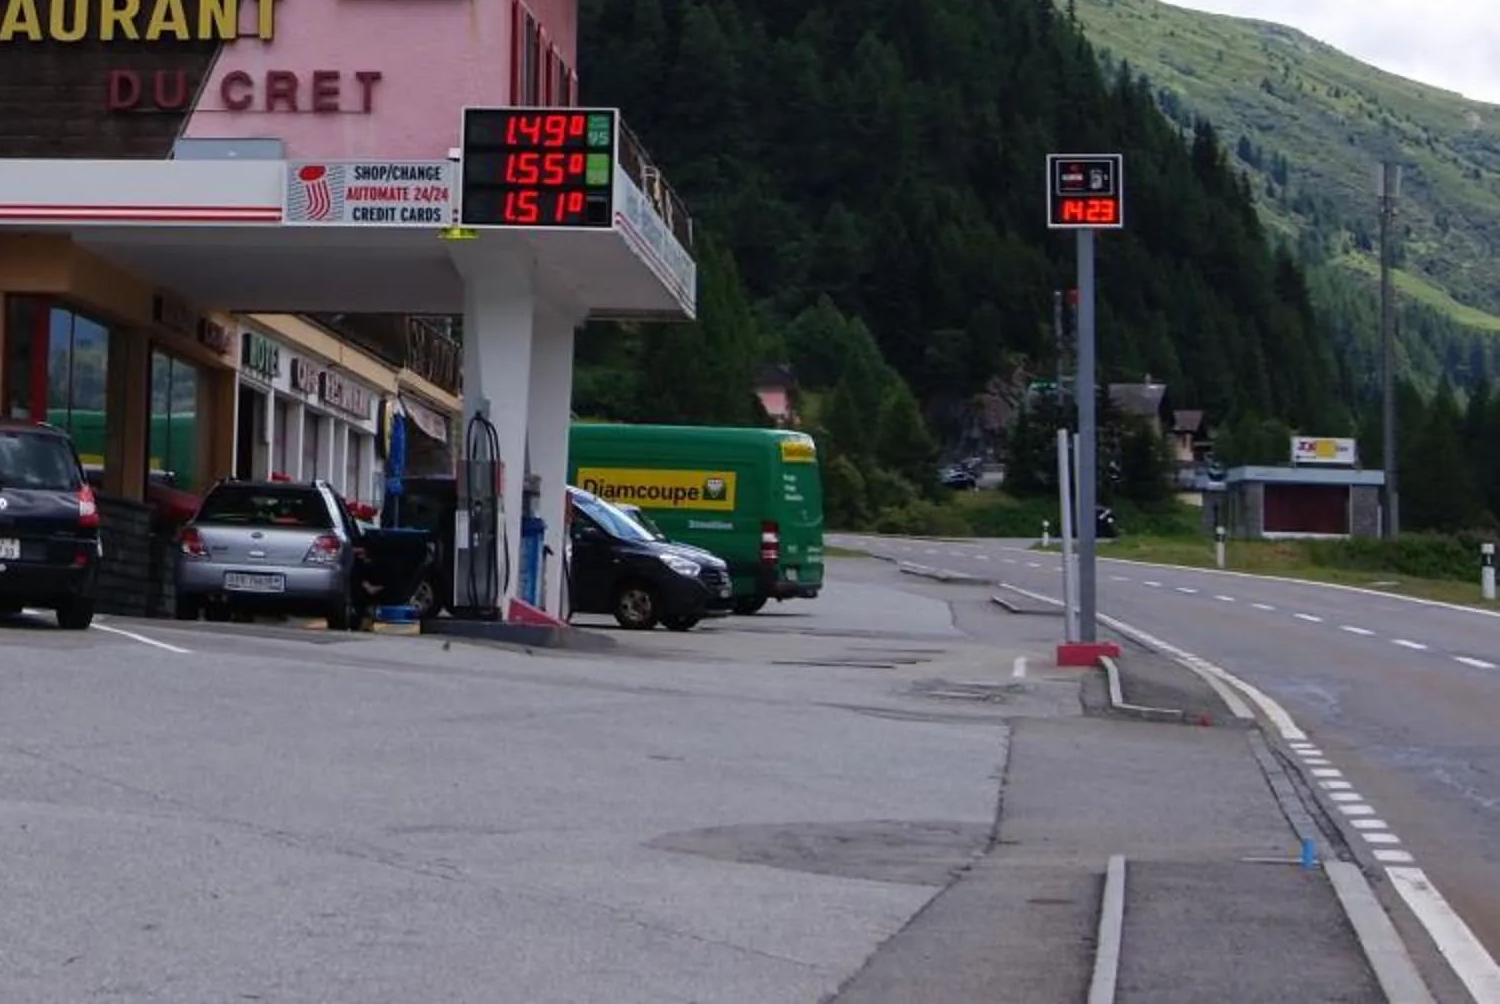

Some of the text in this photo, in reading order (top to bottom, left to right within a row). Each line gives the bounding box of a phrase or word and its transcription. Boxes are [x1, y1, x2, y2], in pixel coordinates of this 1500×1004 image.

[106, 69, 382, 114] DU CRET
[354, 165, 441, 182] SHOP/CHANGE
[345, 186, 449, 203] AUTOMATE 24/24
[352, 207, 441, 223] CREDIT CARDS
[583, 478, 699, 504] Diamcoupe
